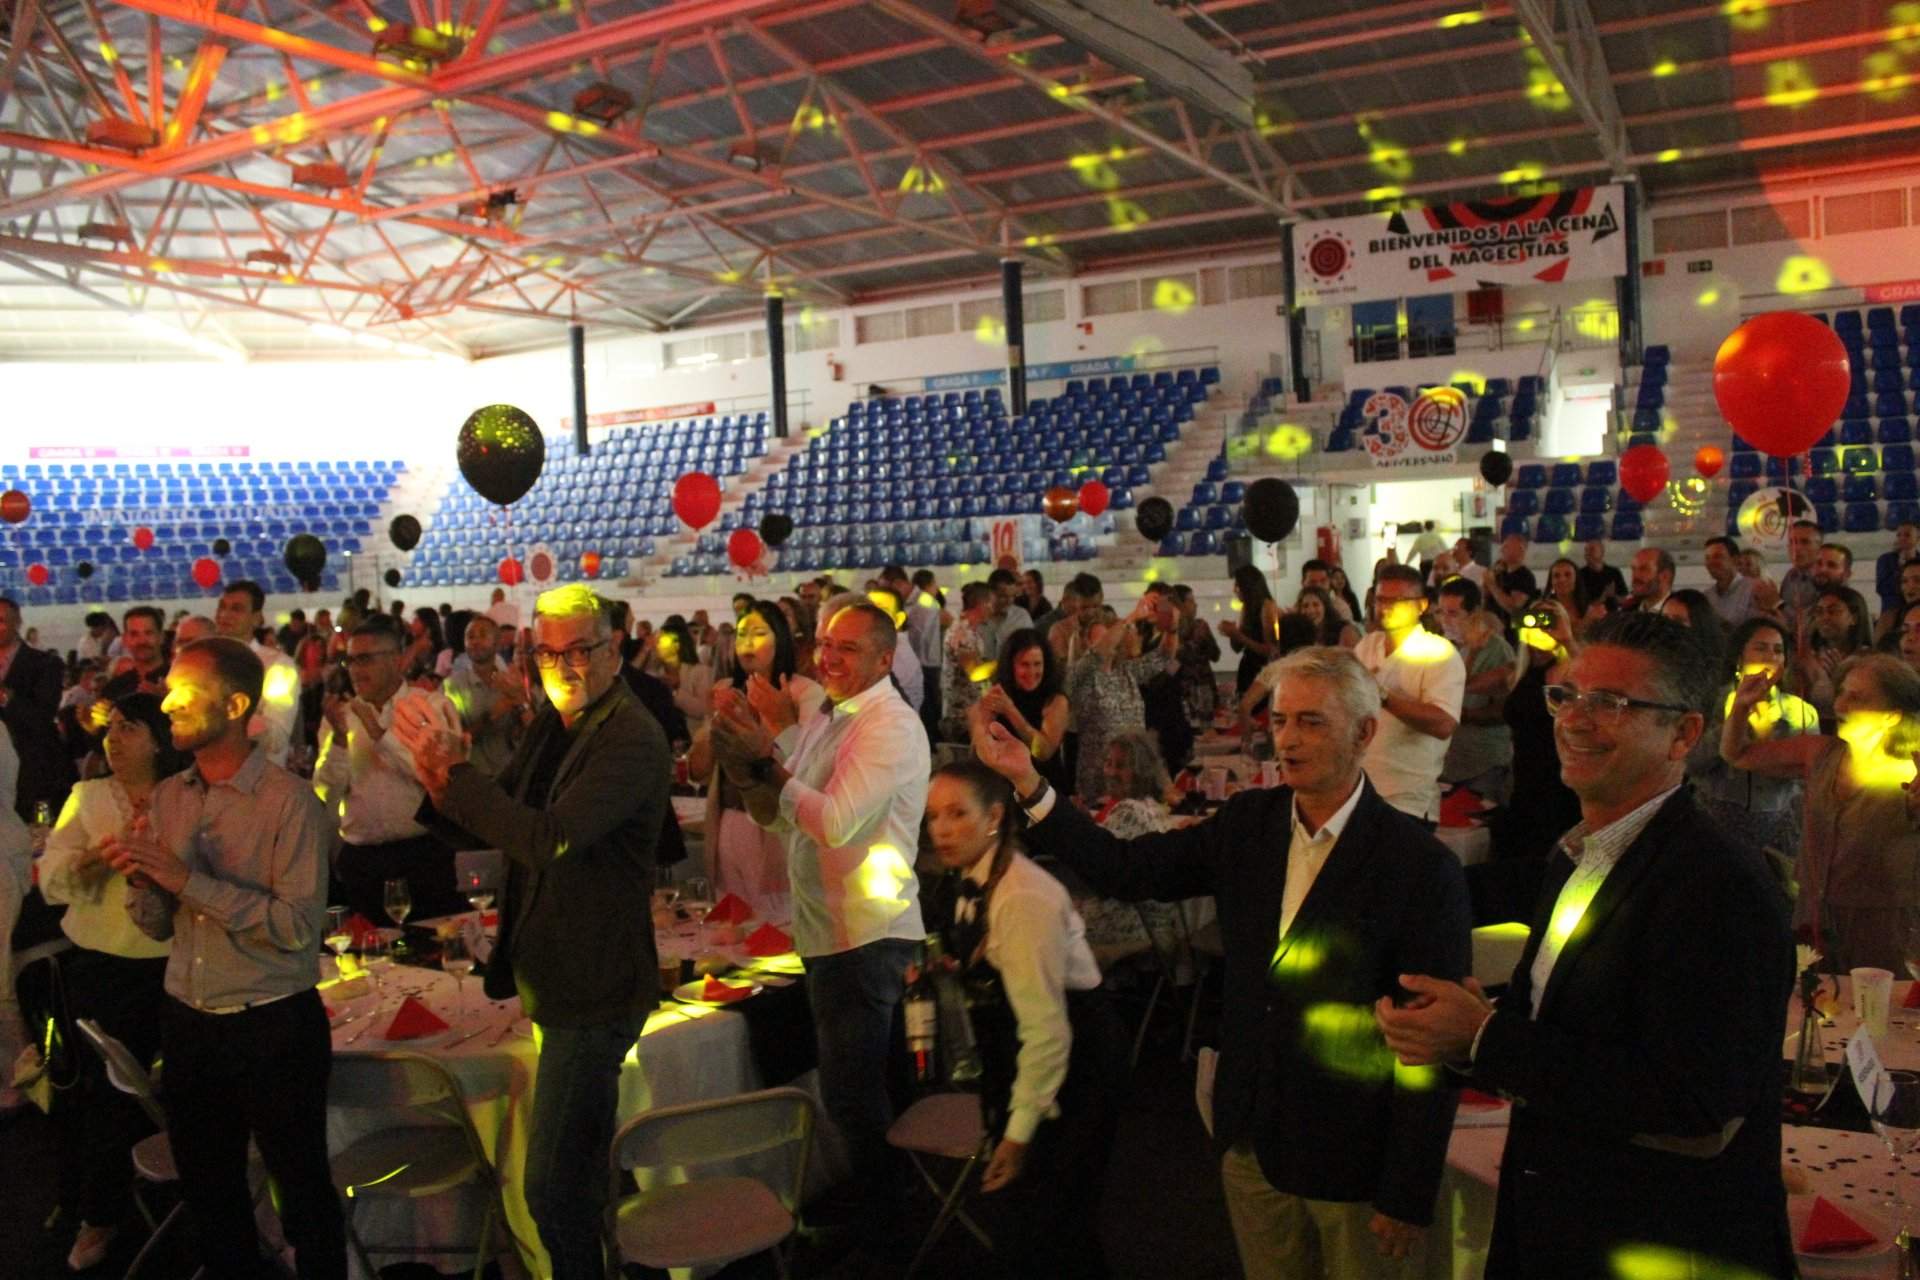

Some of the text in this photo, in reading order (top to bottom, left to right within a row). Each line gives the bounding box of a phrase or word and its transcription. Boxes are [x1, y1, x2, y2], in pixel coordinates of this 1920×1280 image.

[1369, 213, 1610, 254] BIENVENIDOS A LA CENA
[1409, 240, 1569, 270] DEL MAGEC TIAS
